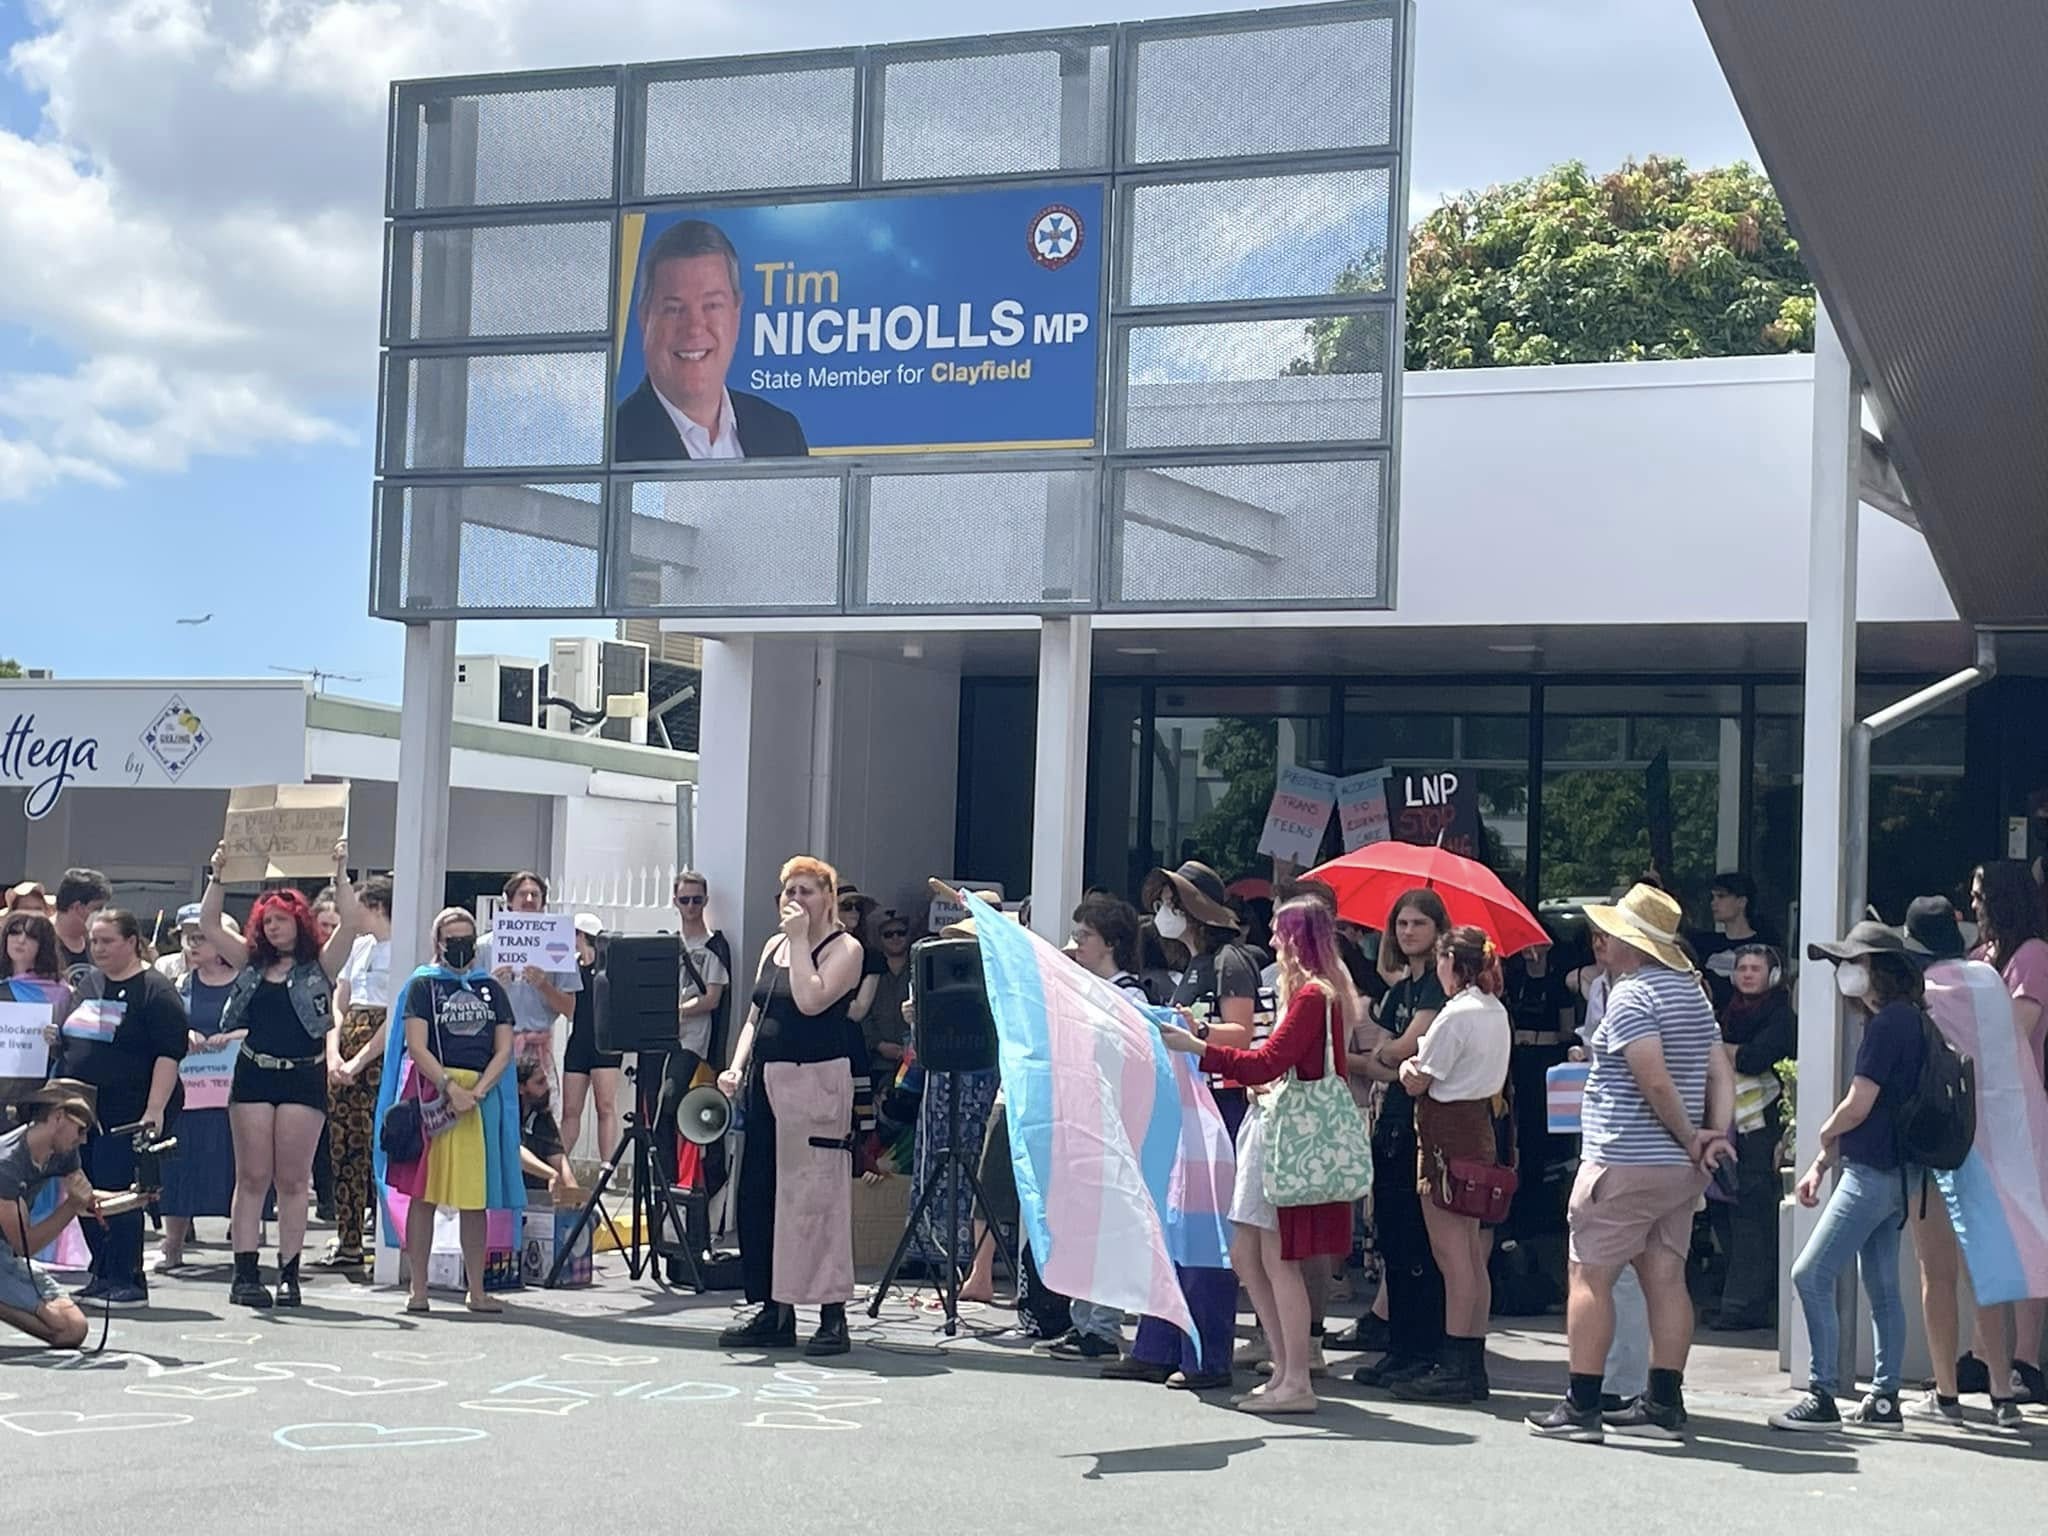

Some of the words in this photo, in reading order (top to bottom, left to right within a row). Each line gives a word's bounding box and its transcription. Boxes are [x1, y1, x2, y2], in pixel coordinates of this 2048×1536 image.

[754, 262, 839, 306] Tim
[753, 300, 1025, 356] NICHOLLS
[1033, 312, 1089, 345] MP
[750, 369, 802, 390] State
[808, 366, 891, 387] Member
[896, 363, 926, 385] for
[931, 358, 1031, 386] Clayfield
[124, 751, 145, 785] by
[1405, 772, 1459, 807] LNP
[1280, 795, 1319, 815] TRANS
[1273, 818, 1314, 839] TEENS
[1399, 805, 1456, 835] STOP
[498, 920, 557, 931] PROTECT
[498, 936, 541, 947] TRANS
[498, 952, 528, 963] KIDS
[8, 1039, 33, 1049] lives
